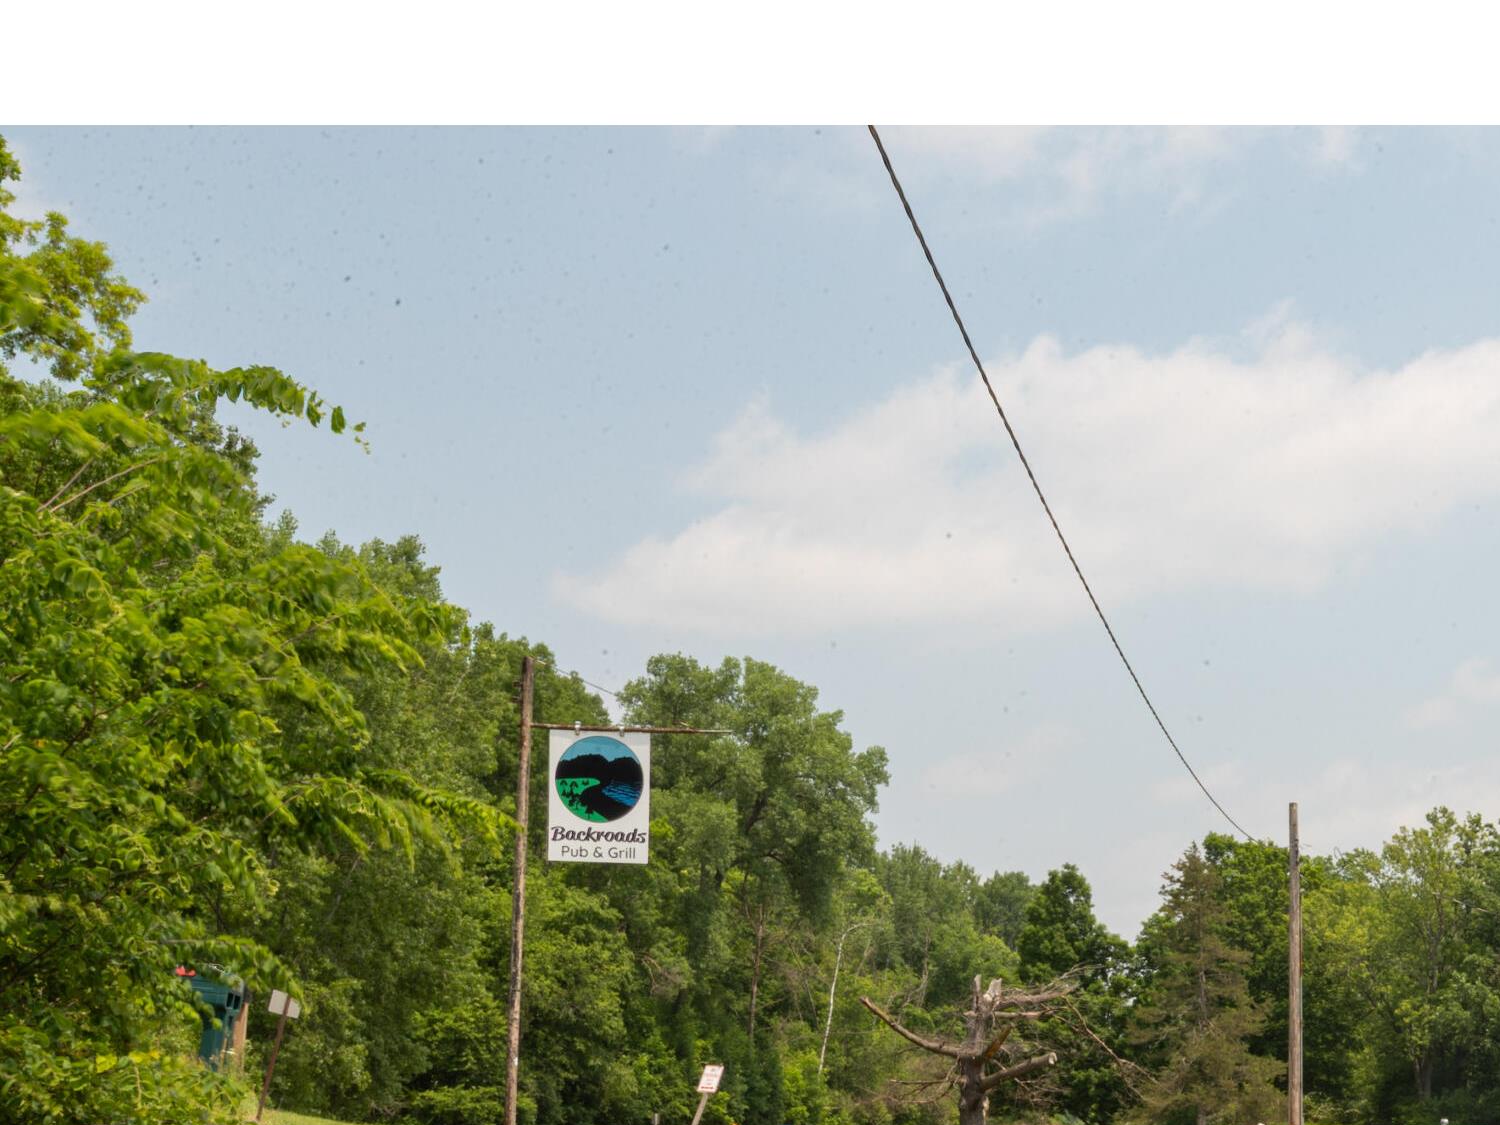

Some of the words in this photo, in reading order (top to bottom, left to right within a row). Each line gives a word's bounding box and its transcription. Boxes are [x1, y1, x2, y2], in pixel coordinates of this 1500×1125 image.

[551, 826, 647, 844] Backroads
[561, 846, 589, 858] Pub
[593, 846, 603, 858] &
[608, 847, 636, 859] Grill
